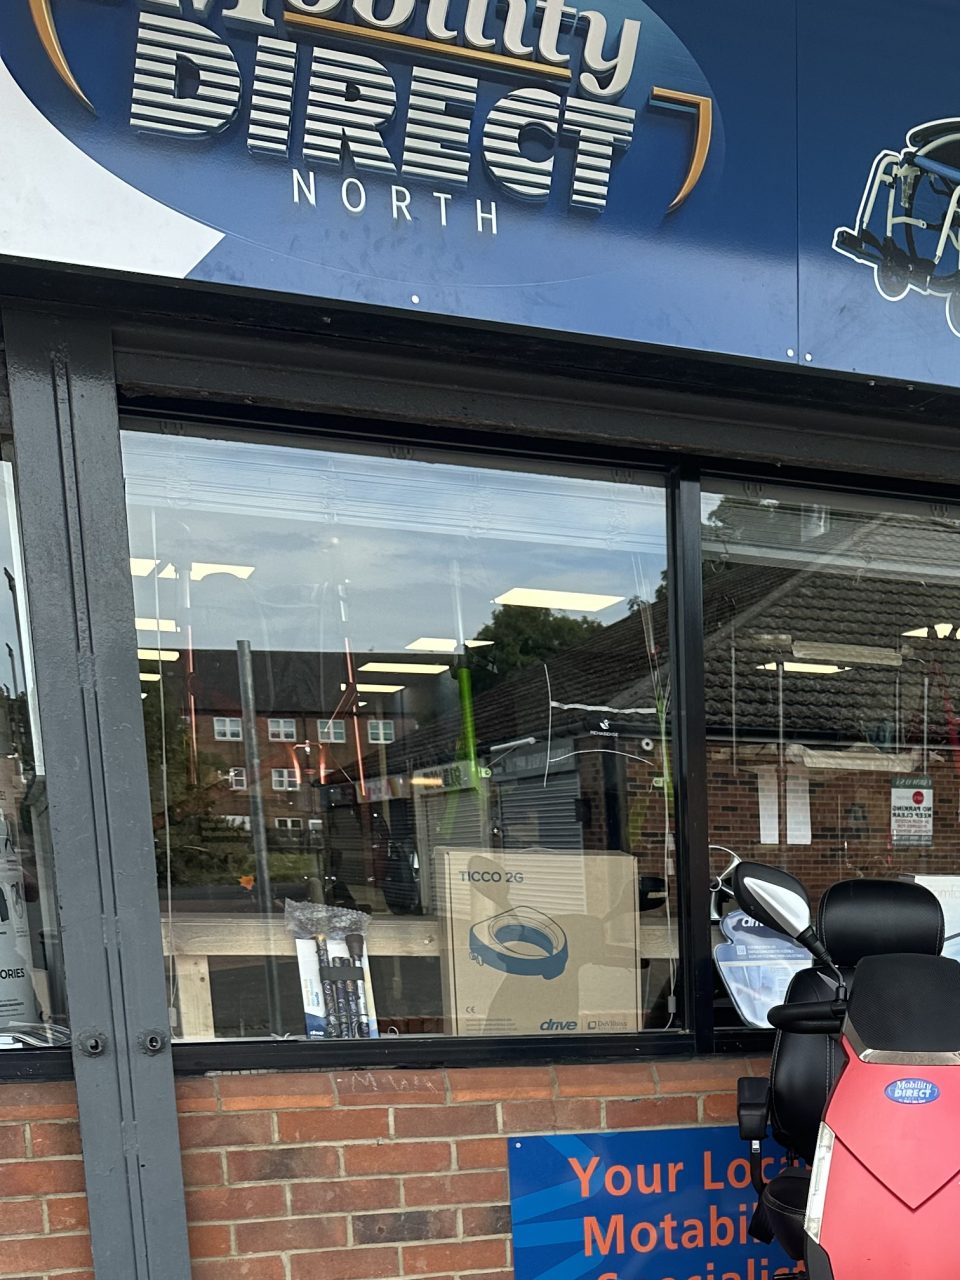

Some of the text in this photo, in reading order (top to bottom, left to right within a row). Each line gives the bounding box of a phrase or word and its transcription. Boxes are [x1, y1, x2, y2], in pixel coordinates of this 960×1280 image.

[143, 0, 641, 97] ility
[130, 11, 636, 212] DIRECT
[292, 168, 499, 235] NORTH
[459, 871, 524, 883] TICCO 2G
[539, 1018, 578, 1031] drive
[894, 1089, 932, 1098] DIRECT
[896, 1080, 932, 1090] Mobility
[567, 1150, 812, 1197] Your Loc
[583, 1202, 765, 1257] Motabi
